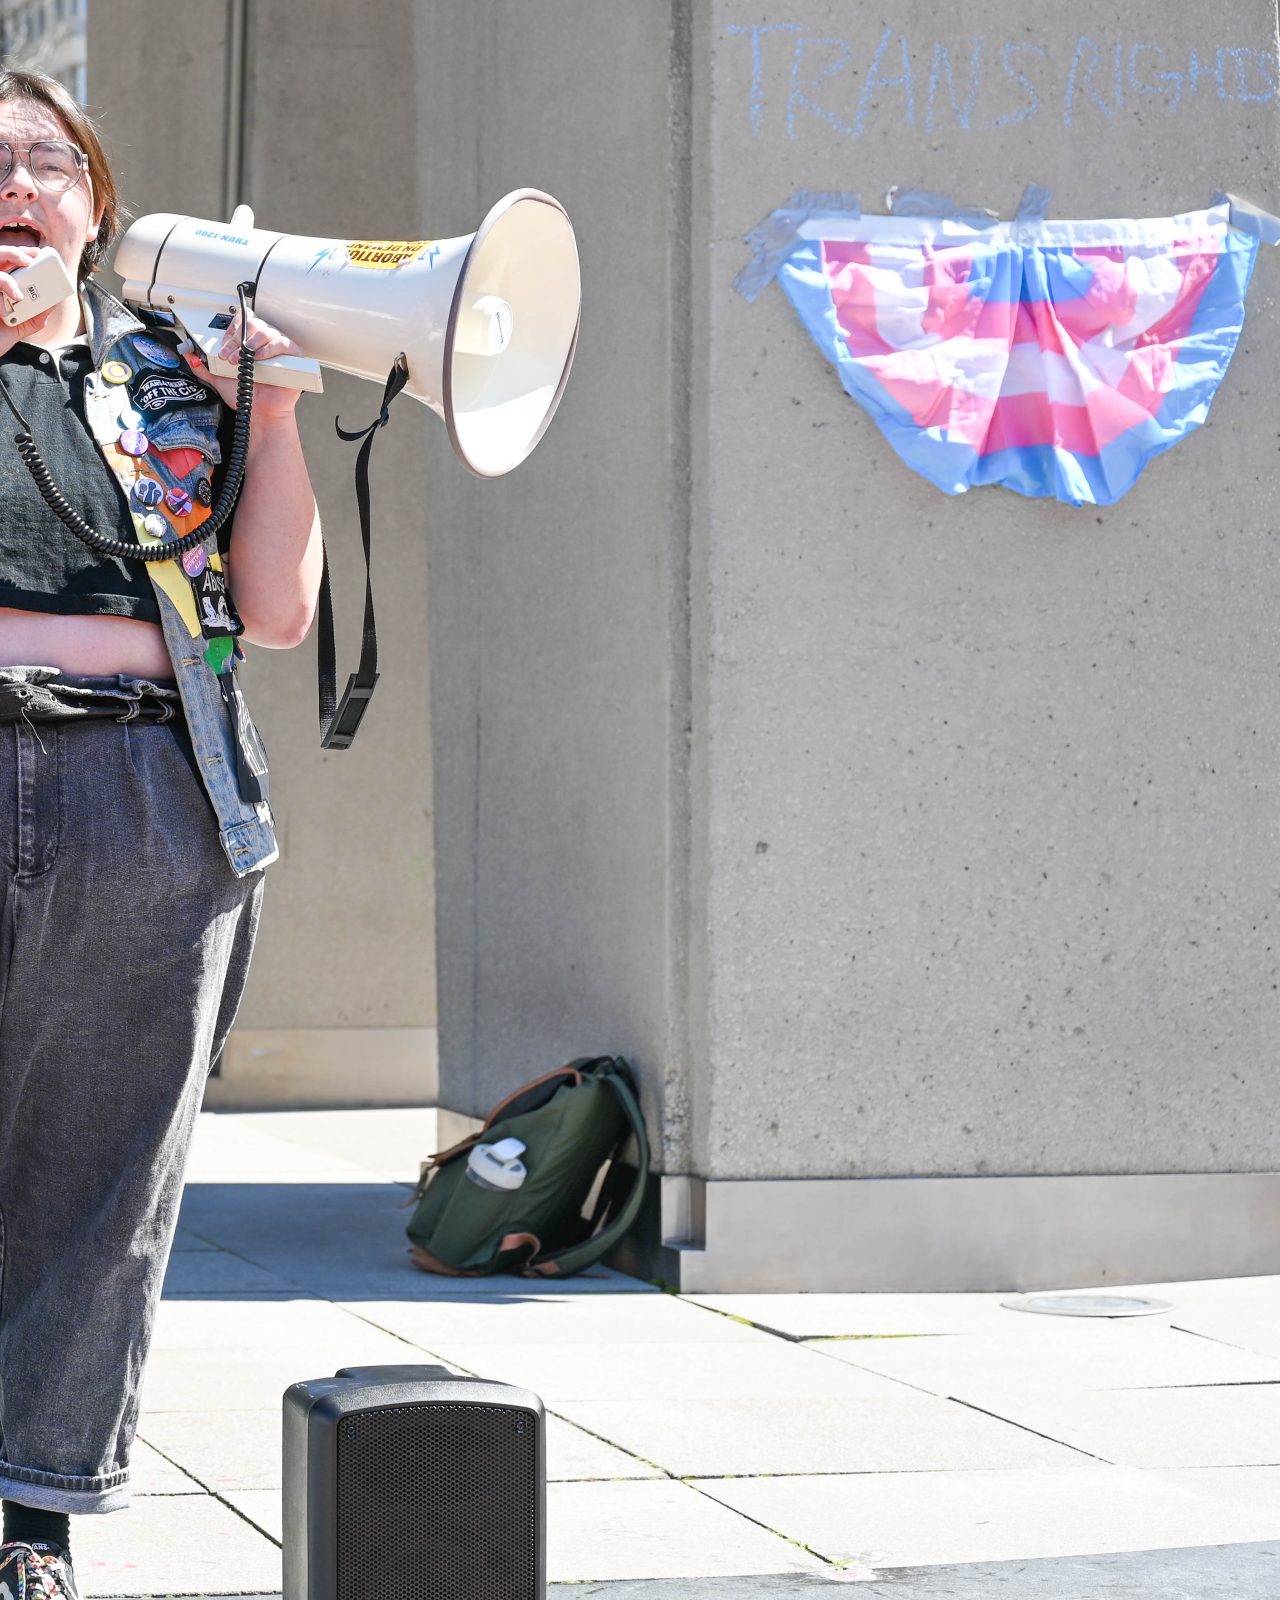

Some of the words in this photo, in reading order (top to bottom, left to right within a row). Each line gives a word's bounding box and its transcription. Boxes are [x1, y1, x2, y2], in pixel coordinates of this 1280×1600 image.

[725, 22, 1048, 140] TRANS
[27, 285, 39, 300] MIC
[158, 386, 181, 397] THE
